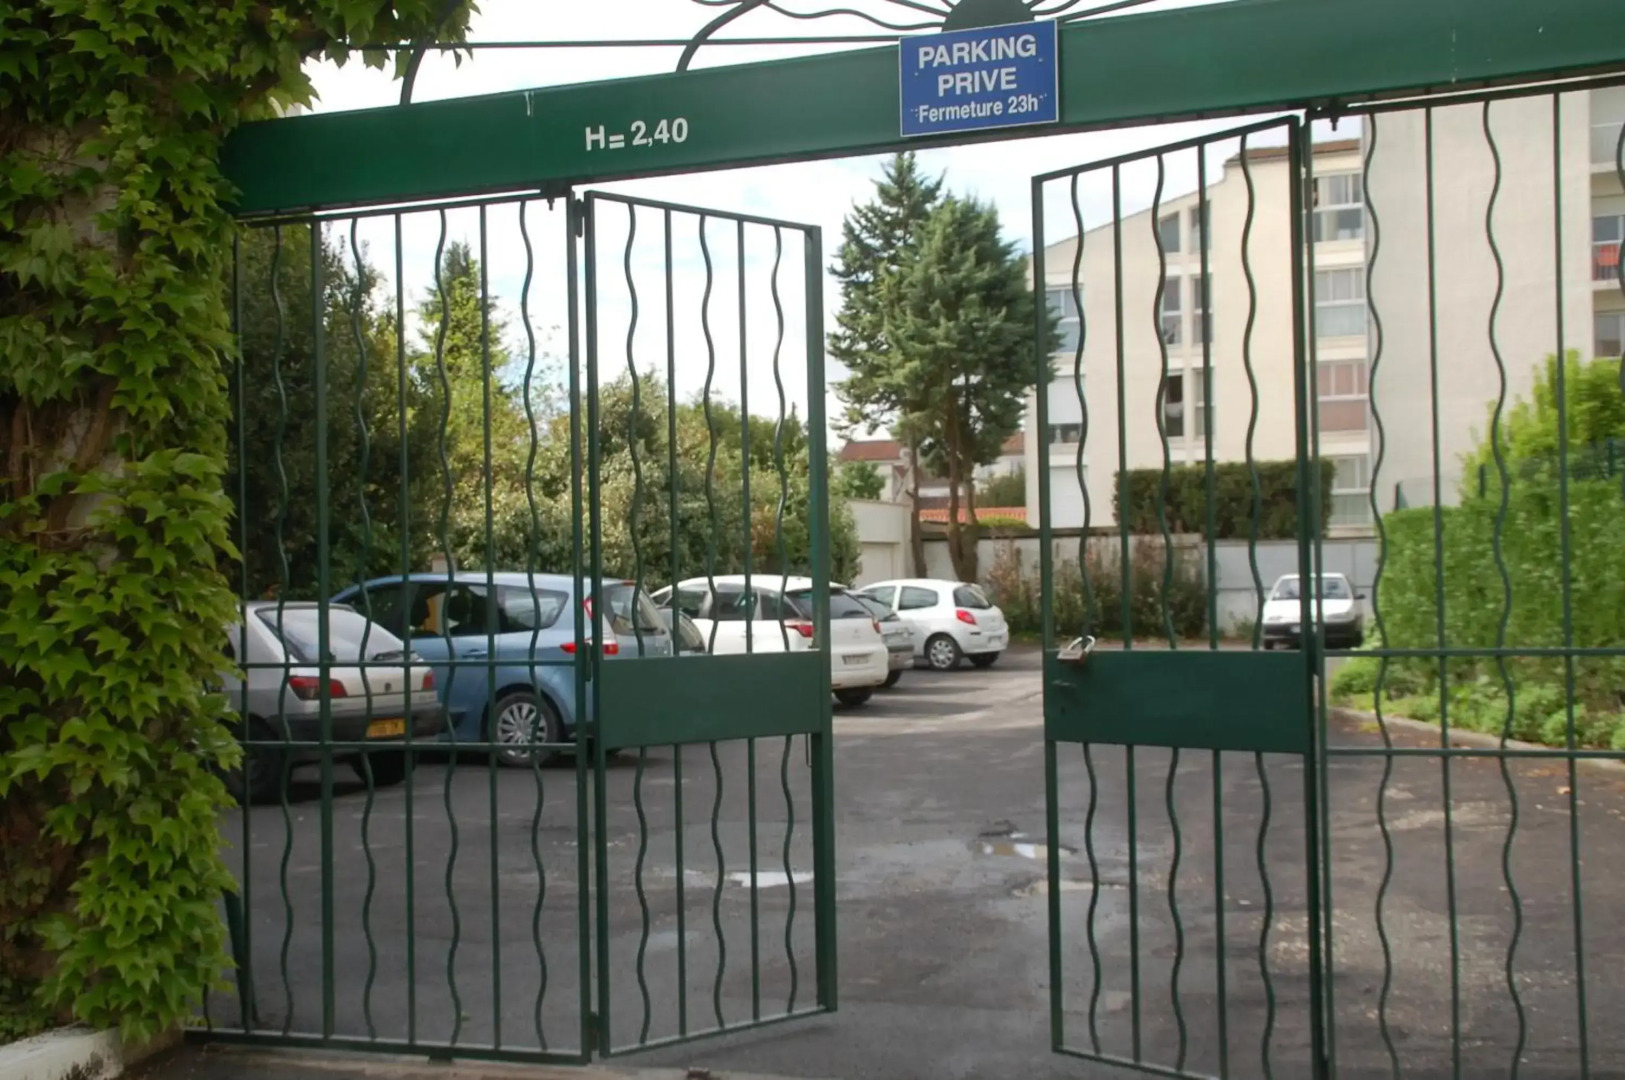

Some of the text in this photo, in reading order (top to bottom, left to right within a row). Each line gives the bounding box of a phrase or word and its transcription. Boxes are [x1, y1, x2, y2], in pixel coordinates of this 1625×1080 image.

[918, 34, 1037, 69] PARKING
[938, 67, 1017, 97] PRIVE
[918, 94, 1038, 123] Fermeture 23h
